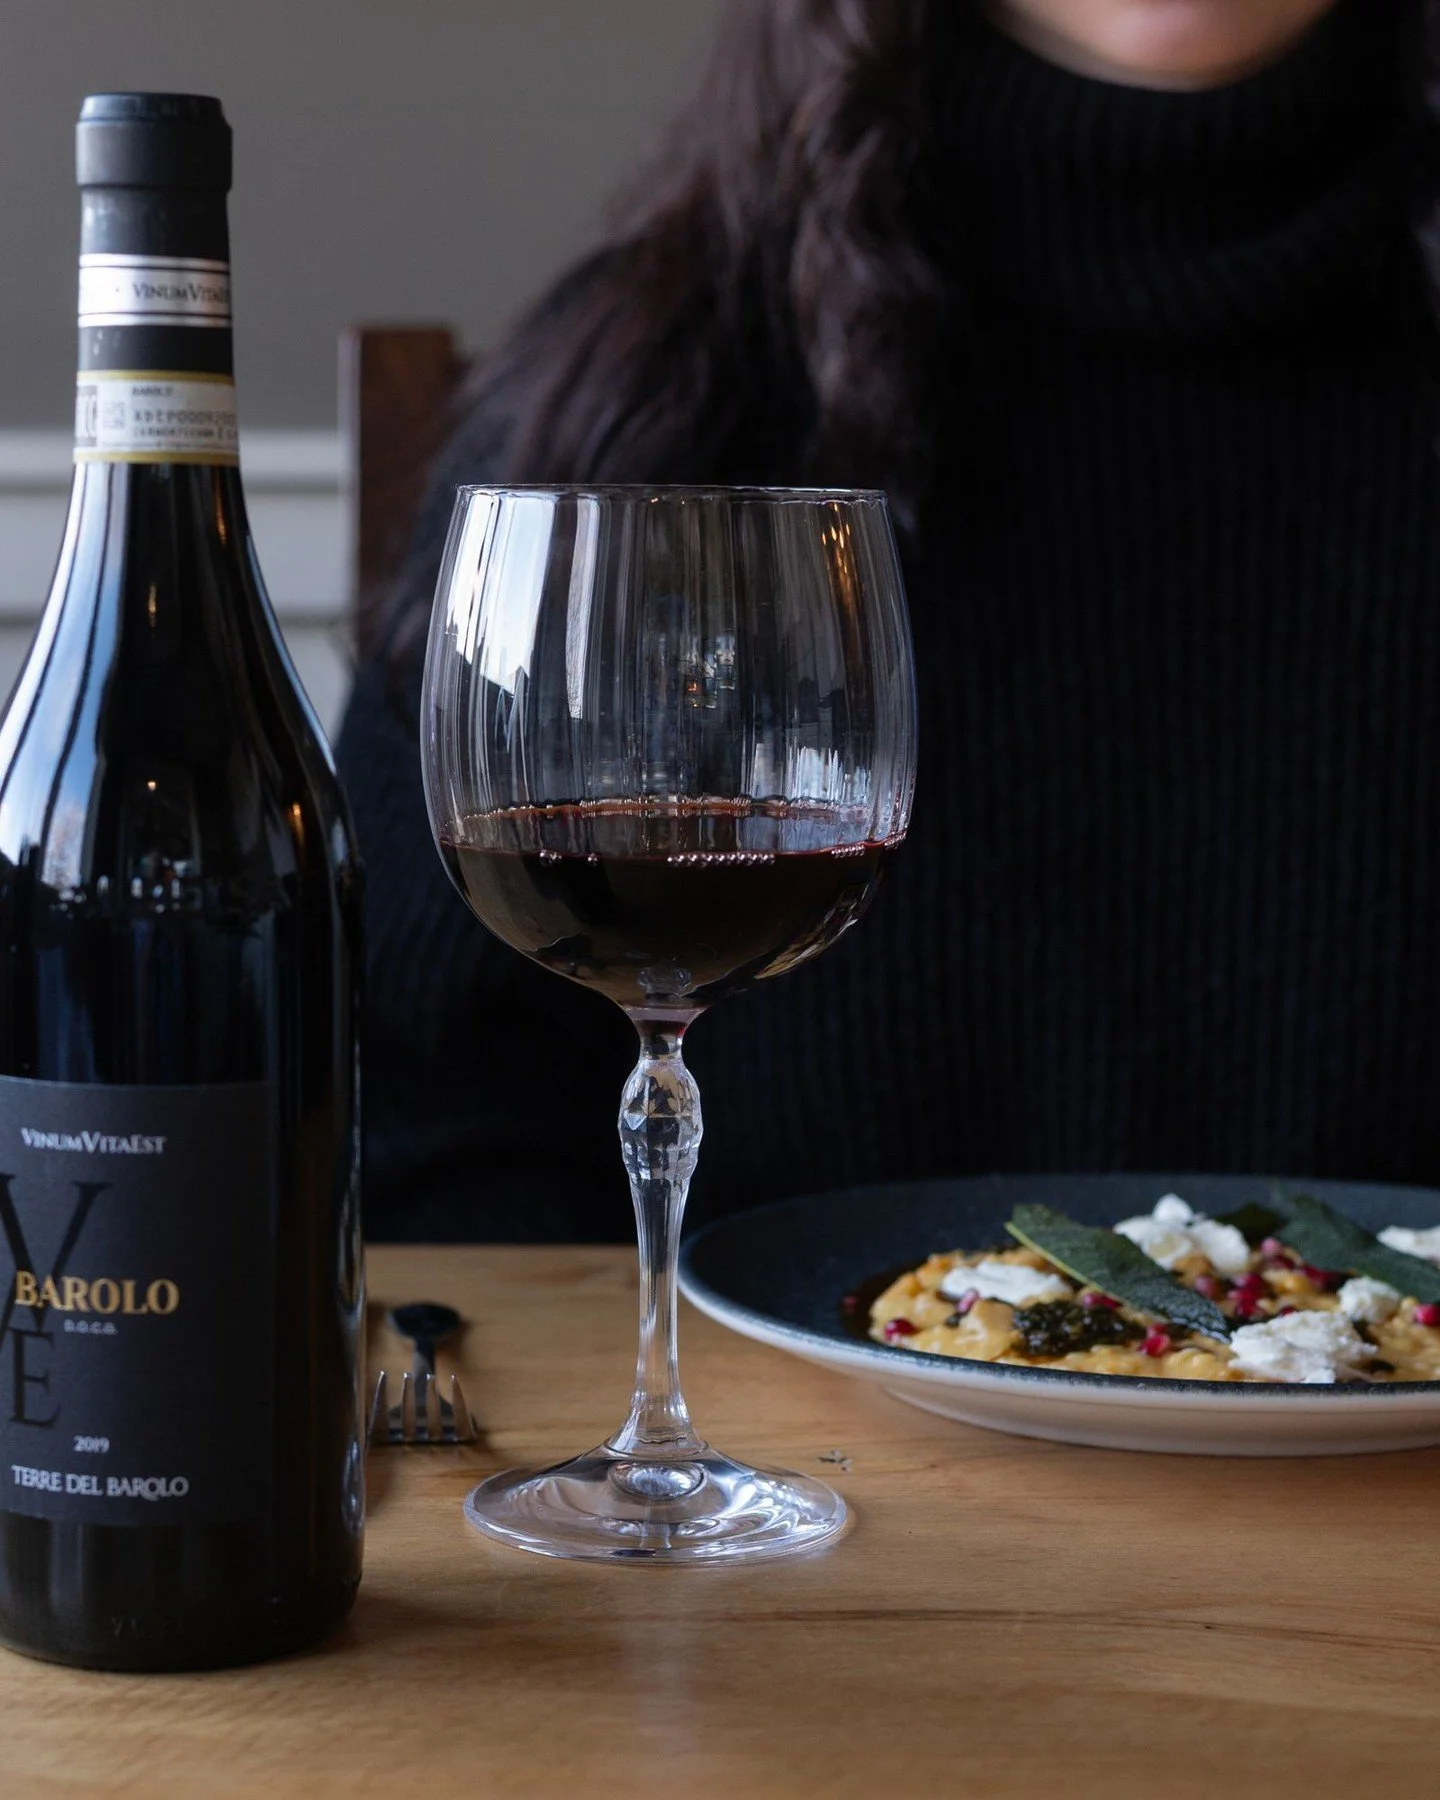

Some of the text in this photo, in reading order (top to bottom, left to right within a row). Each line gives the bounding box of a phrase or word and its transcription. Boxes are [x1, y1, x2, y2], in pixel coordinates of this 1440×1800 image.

[15, 1270, 179, 1315] BAROLO
[73, 1435, 109, 1453] 2019
[11, 1464, 189, 1501] TERRE DEL BAROLO
